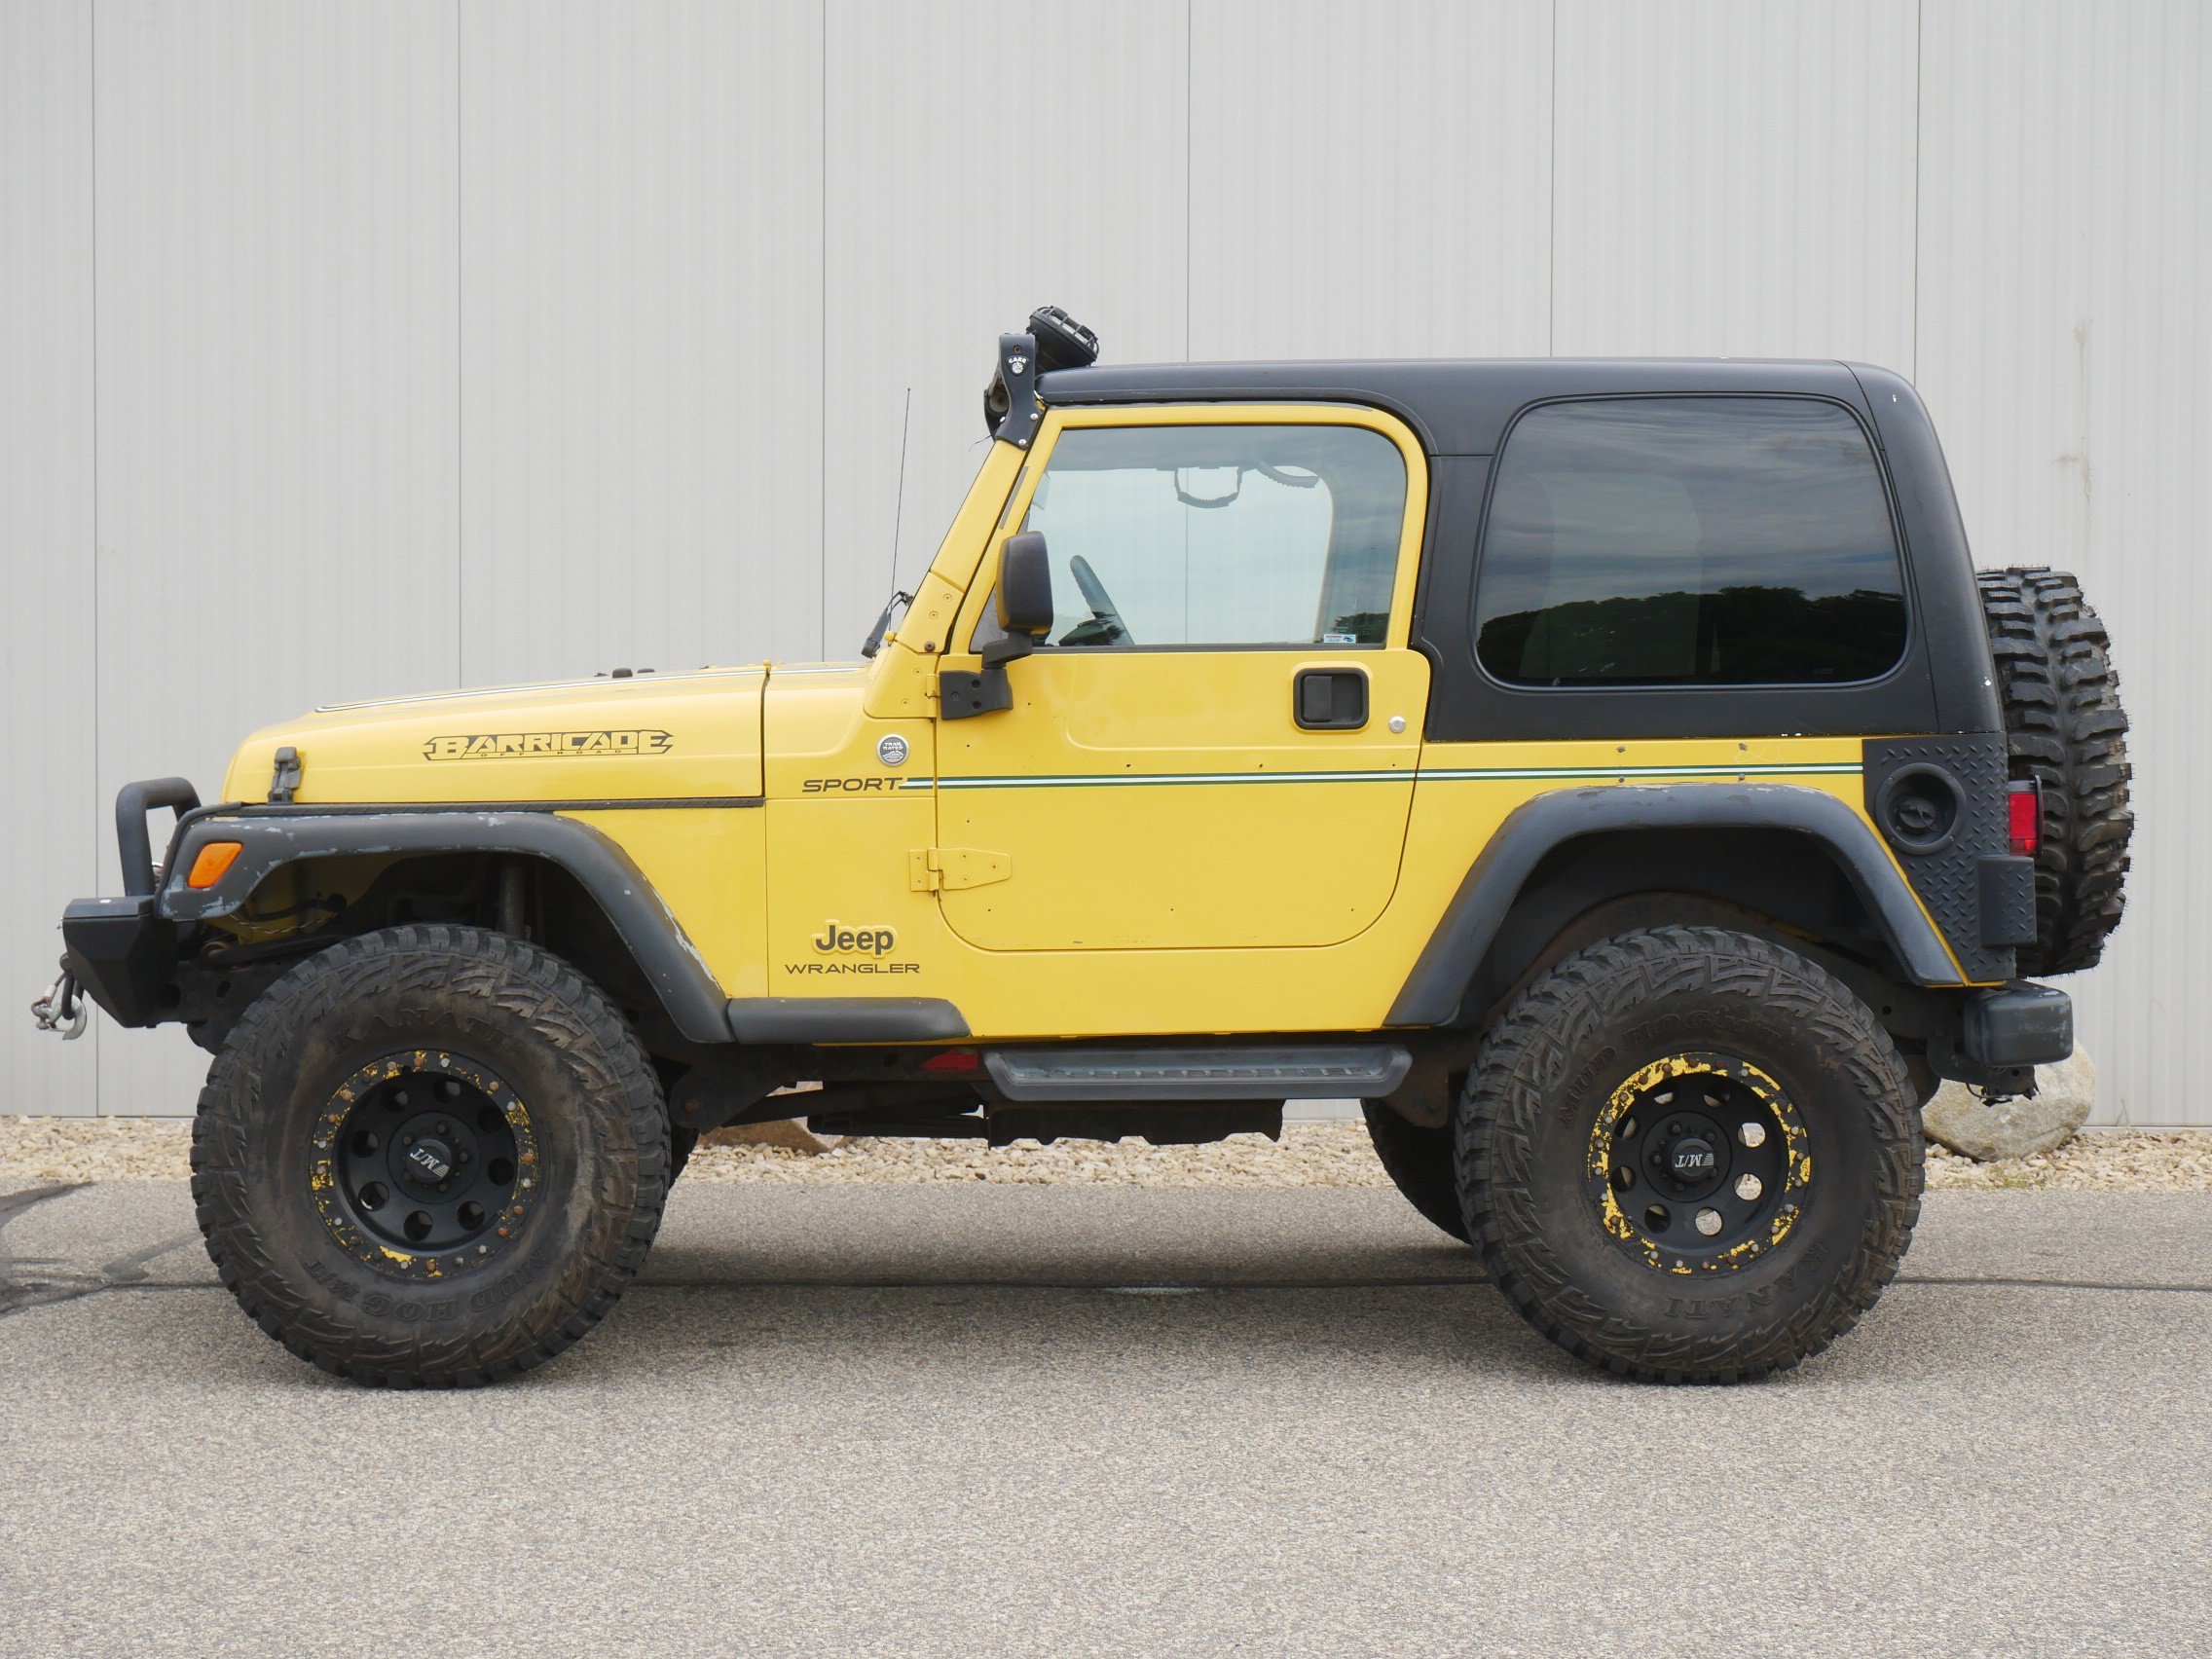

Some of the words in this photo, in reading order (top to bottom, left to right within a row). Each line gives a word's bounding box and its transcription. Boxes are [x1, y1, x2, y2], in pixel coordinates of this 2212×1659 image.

[423, 729, 674, 760] BARRICADE
[802, 777, 903, 793] SPORT
[815, 924, 894, 955] Jeep
[784, 963, 920, 974] WRANGLER
[468, 1249, 549, 1313] MUD
[362, 1292, 461, 1322] HOG
